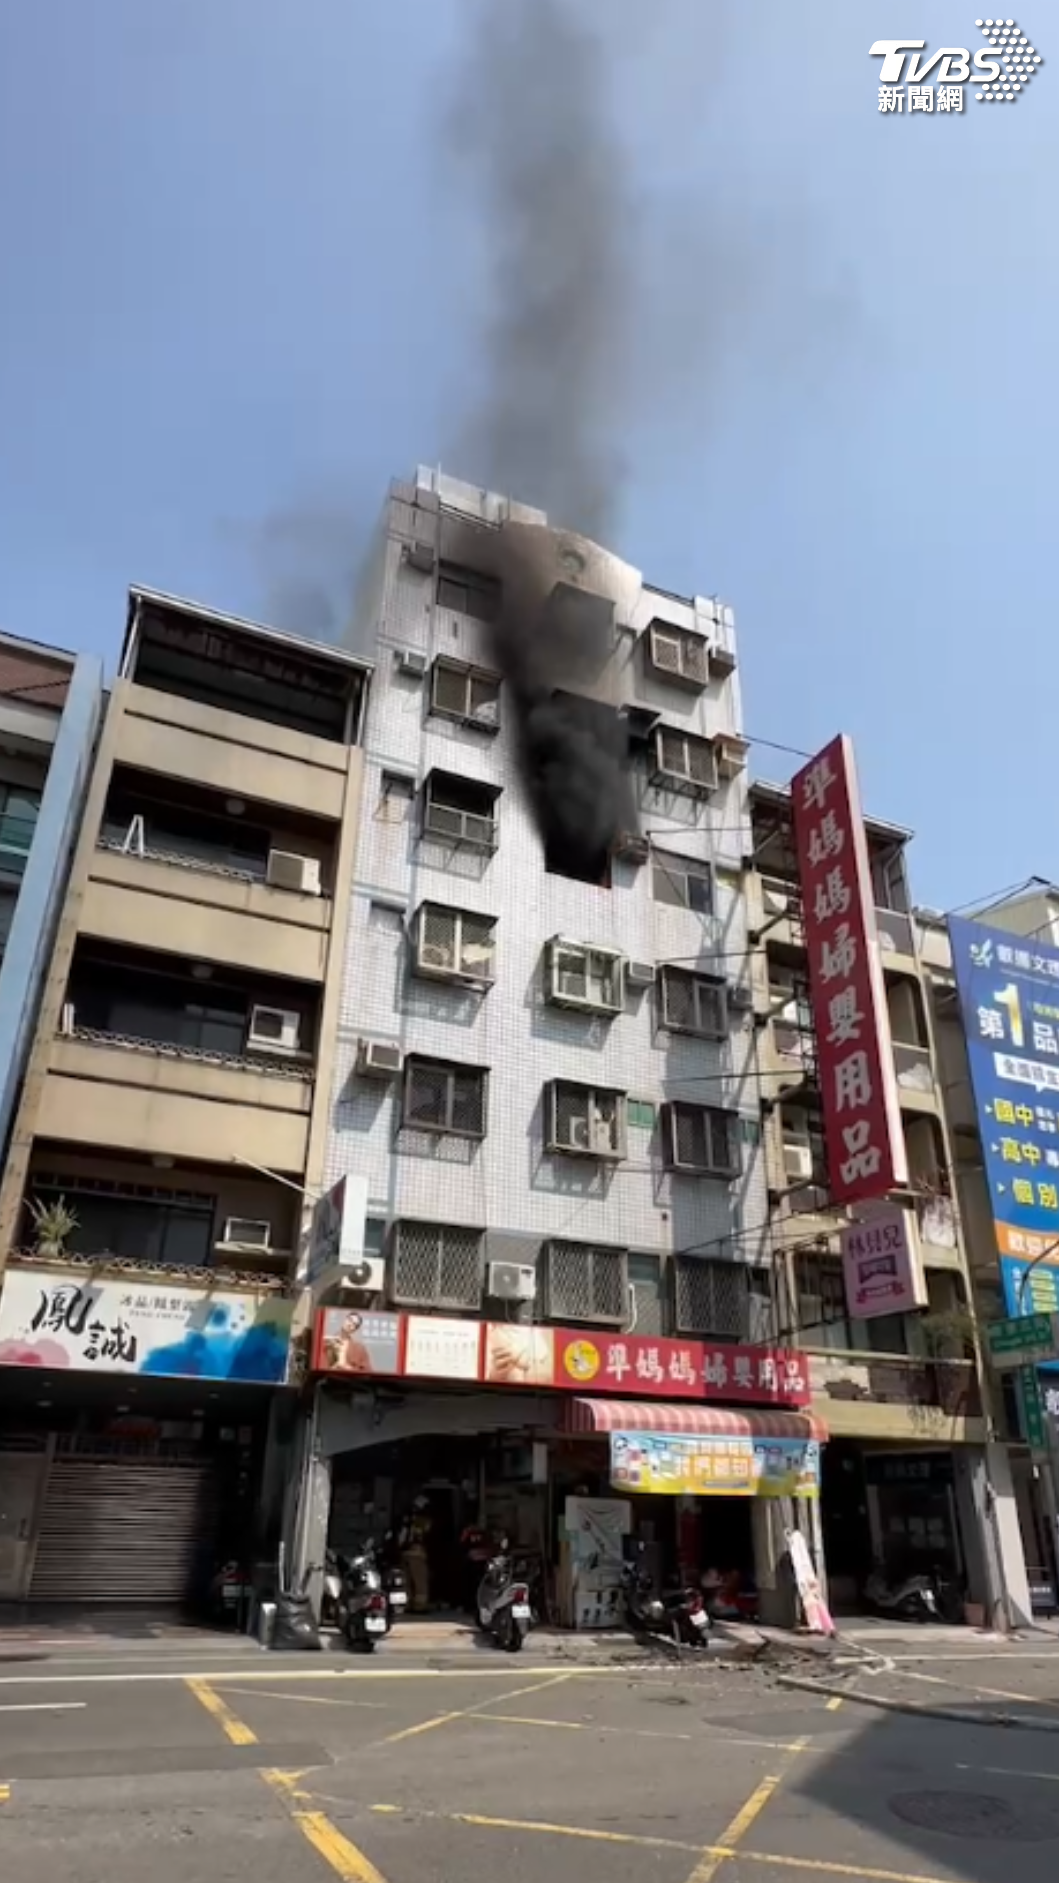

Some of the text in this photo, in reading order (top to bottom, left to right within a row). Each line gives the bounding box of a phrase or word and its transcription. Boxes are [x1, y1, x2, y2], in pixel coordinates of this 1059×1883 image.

[606, 1342, 805, 1393] 準媽媽婦嬰用品
